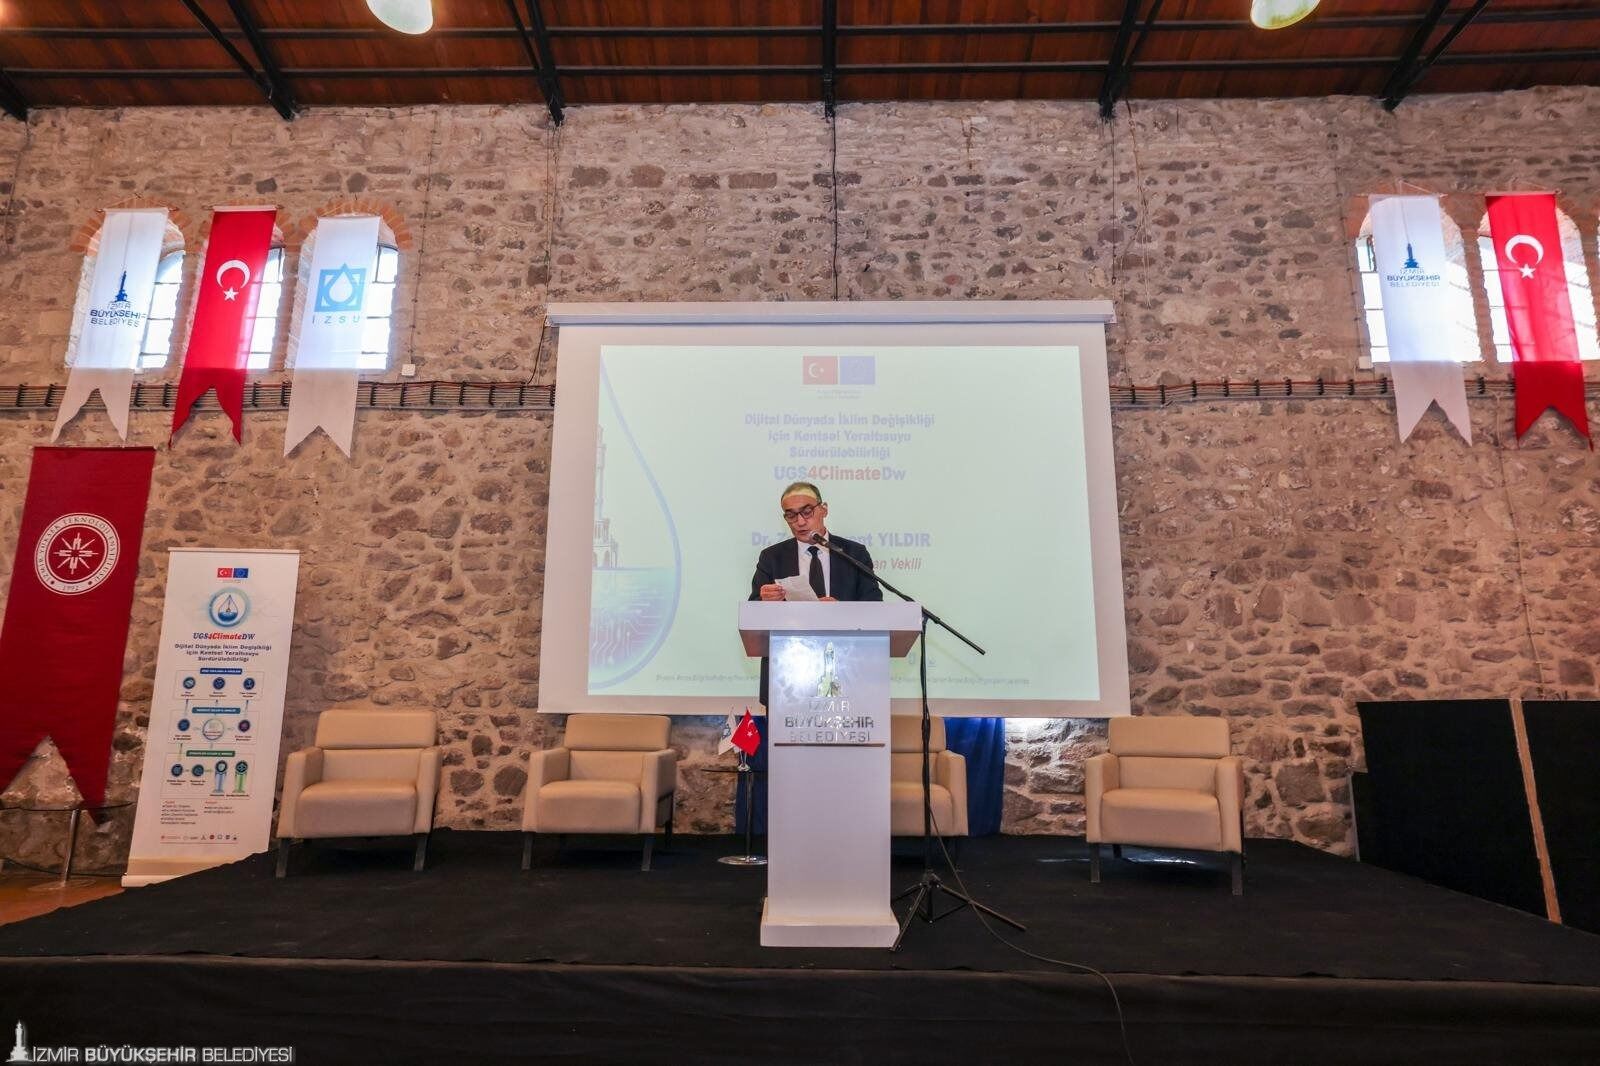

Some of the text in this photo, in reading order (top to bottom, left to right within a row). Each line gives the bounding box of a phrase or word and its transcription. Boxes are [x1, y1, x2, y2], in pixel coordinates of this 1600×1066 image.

[774, 465, 907, 481] UGS4ClimateDw
[751, 532, 772, 547] Dr.
[877, 532, 932, 548] YILDIR
[890, 557, 922, 571] Vekili
